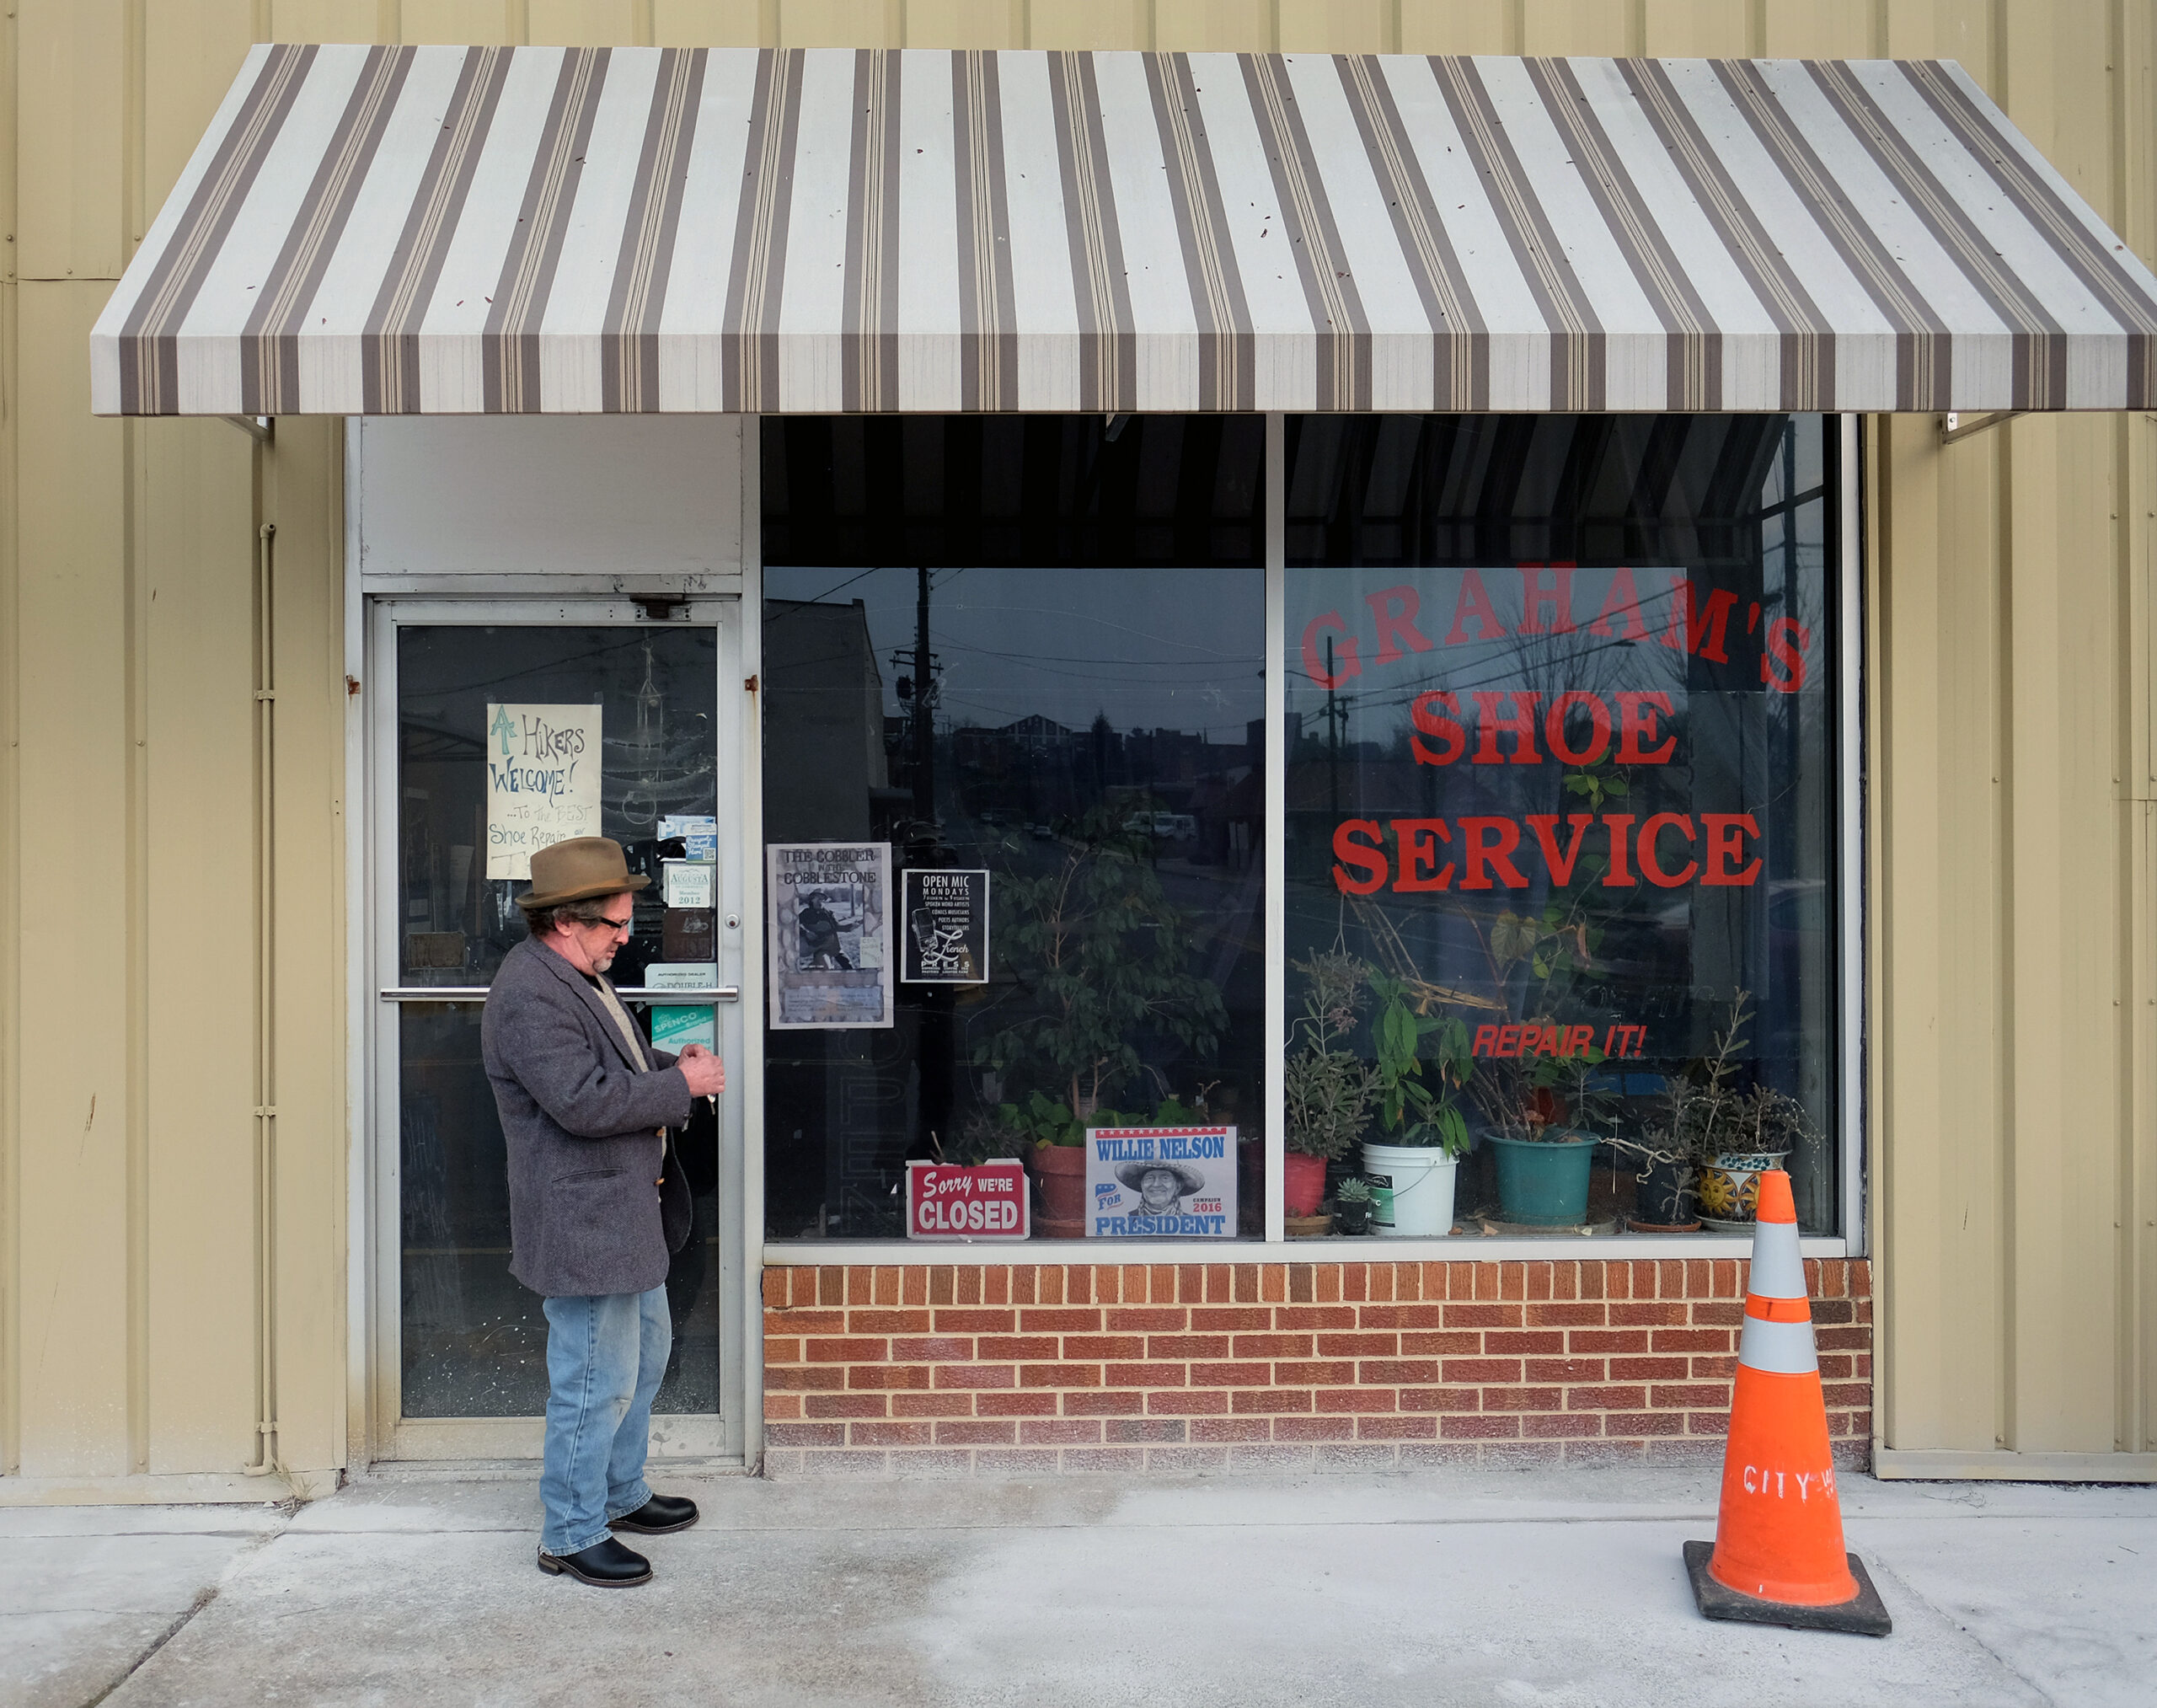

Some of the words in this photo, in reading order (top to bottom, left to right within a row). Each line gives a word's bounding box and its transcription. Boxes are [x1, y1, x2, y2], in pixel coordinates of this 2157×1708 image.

[1300, 560, 1811, 693] GRAHAM'S
[1410, 690, 1678, 767] SHOE
[489, 755, 579, 808] WELCOME!
[555, 804, 593, 822] BEST
[489, 823, 527, 847] Shoe
[531, 826, 566, 849] Repair
[784, 849, 812, 863] THE
[816, 849, 875, 863] COBBLER
[1331, 811, 1764, 896] SERVICE
[671, 873, 709, 883] AUGUSTA
[784, 871, 876, 885] COBBLESTONE
[923, 875, 948, 887] OPEN
[951, 875, 970, 887] MIC
[654, 1012, 697, 1033] SPENCO
[1471, 1025, 1595, 1057] REPAIR
[1603, 1025, 1648, 1057] IT!
[1095, 1138, 1154, 1161] WILLIE
[1159, 1137, 1225, 1160] NELSON
[923, 1171, 973, 1198] Sorry
[977, 1178, 1014, 1192] WE'RE
[1098, 1193, 1121, 1211] FOR
[1192, 1202, 1222, 1213] 2016
[918, 1200, 1018, 1230] CLOSED
[1095, 1215, 1226, 1236] PRESIDENT
[1743, 1464, 1810, 1503] CITY
